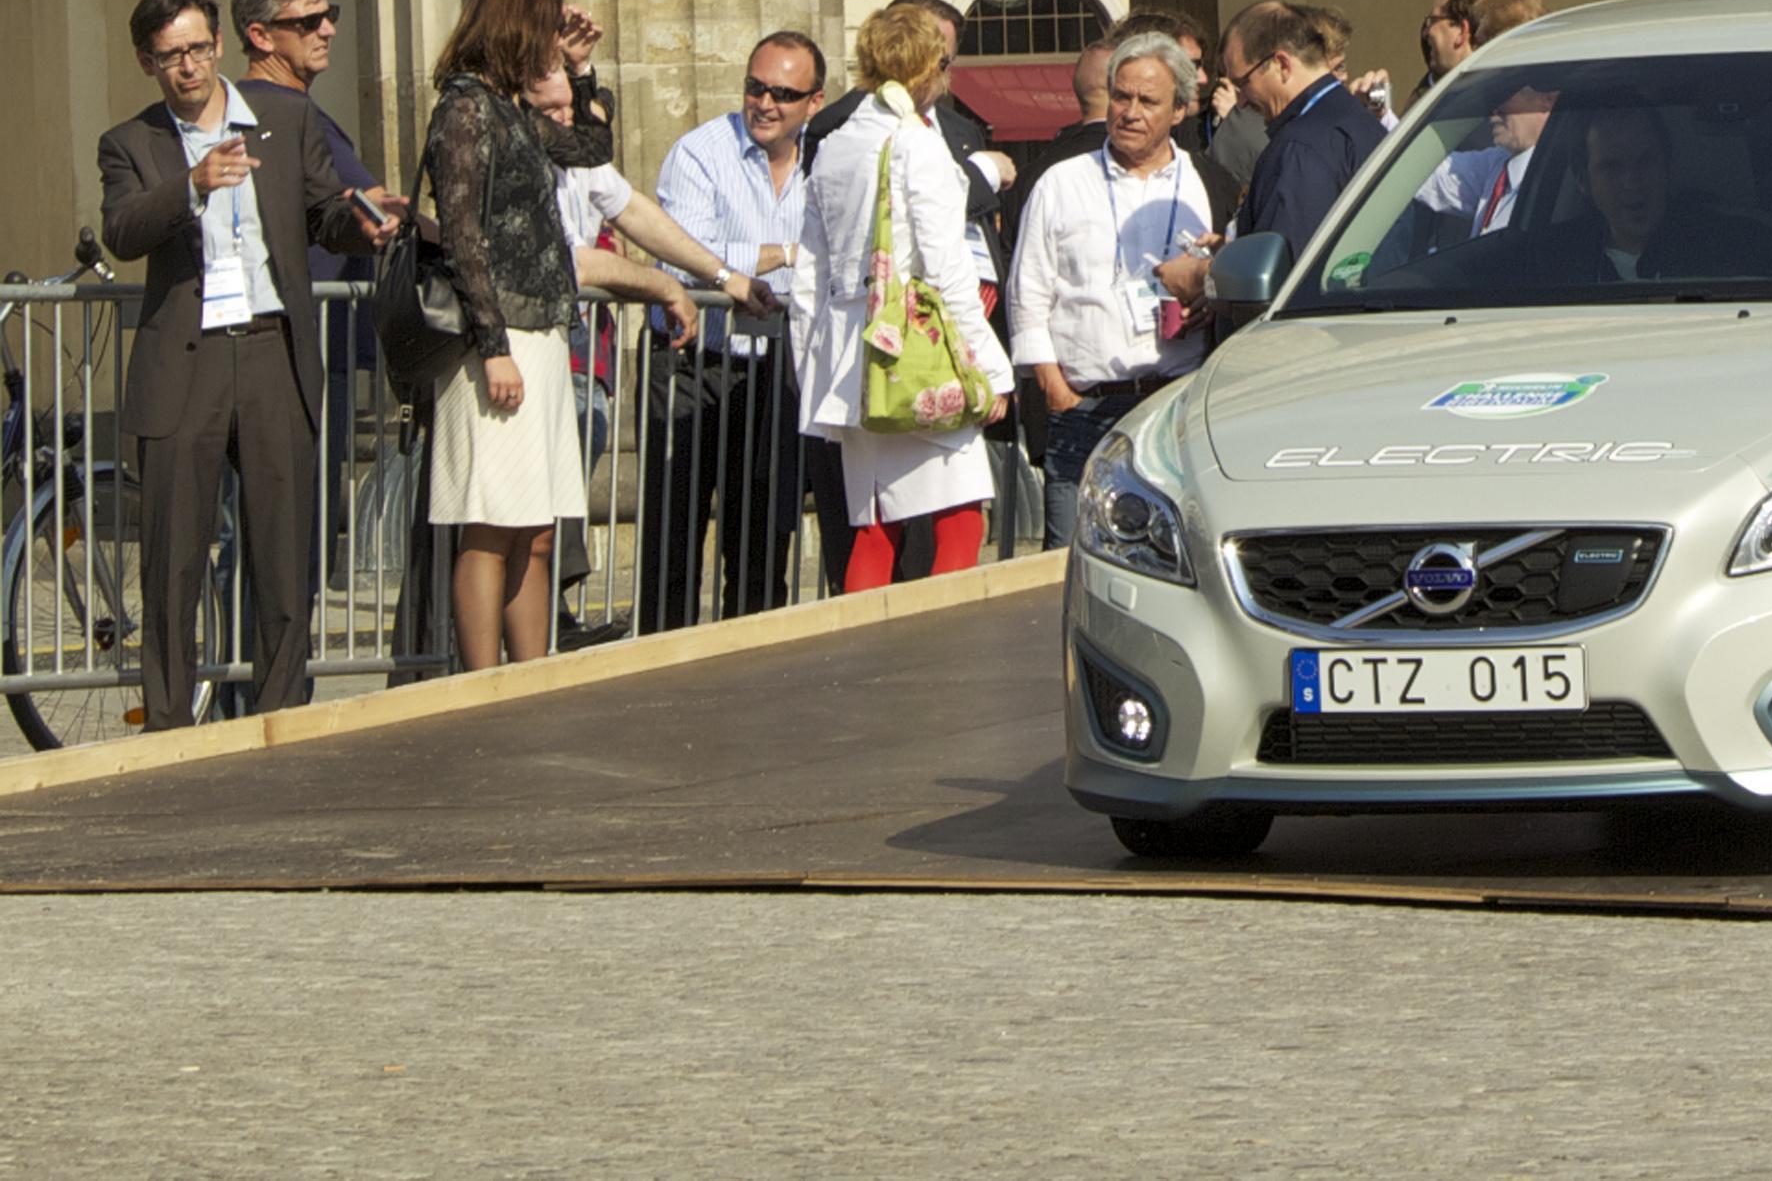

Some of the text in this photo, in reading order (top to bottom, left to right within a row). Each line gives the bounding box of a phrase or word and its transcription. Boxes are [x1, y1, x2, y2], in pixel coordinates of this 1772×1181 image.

[1265, 442, 1674, 468] ELECTRIC
[1410, 572, 1469, 585] VOLVO
[1328, 655, 1571, 704] CTZ 015
[1303, 687, 1314, 702] S
